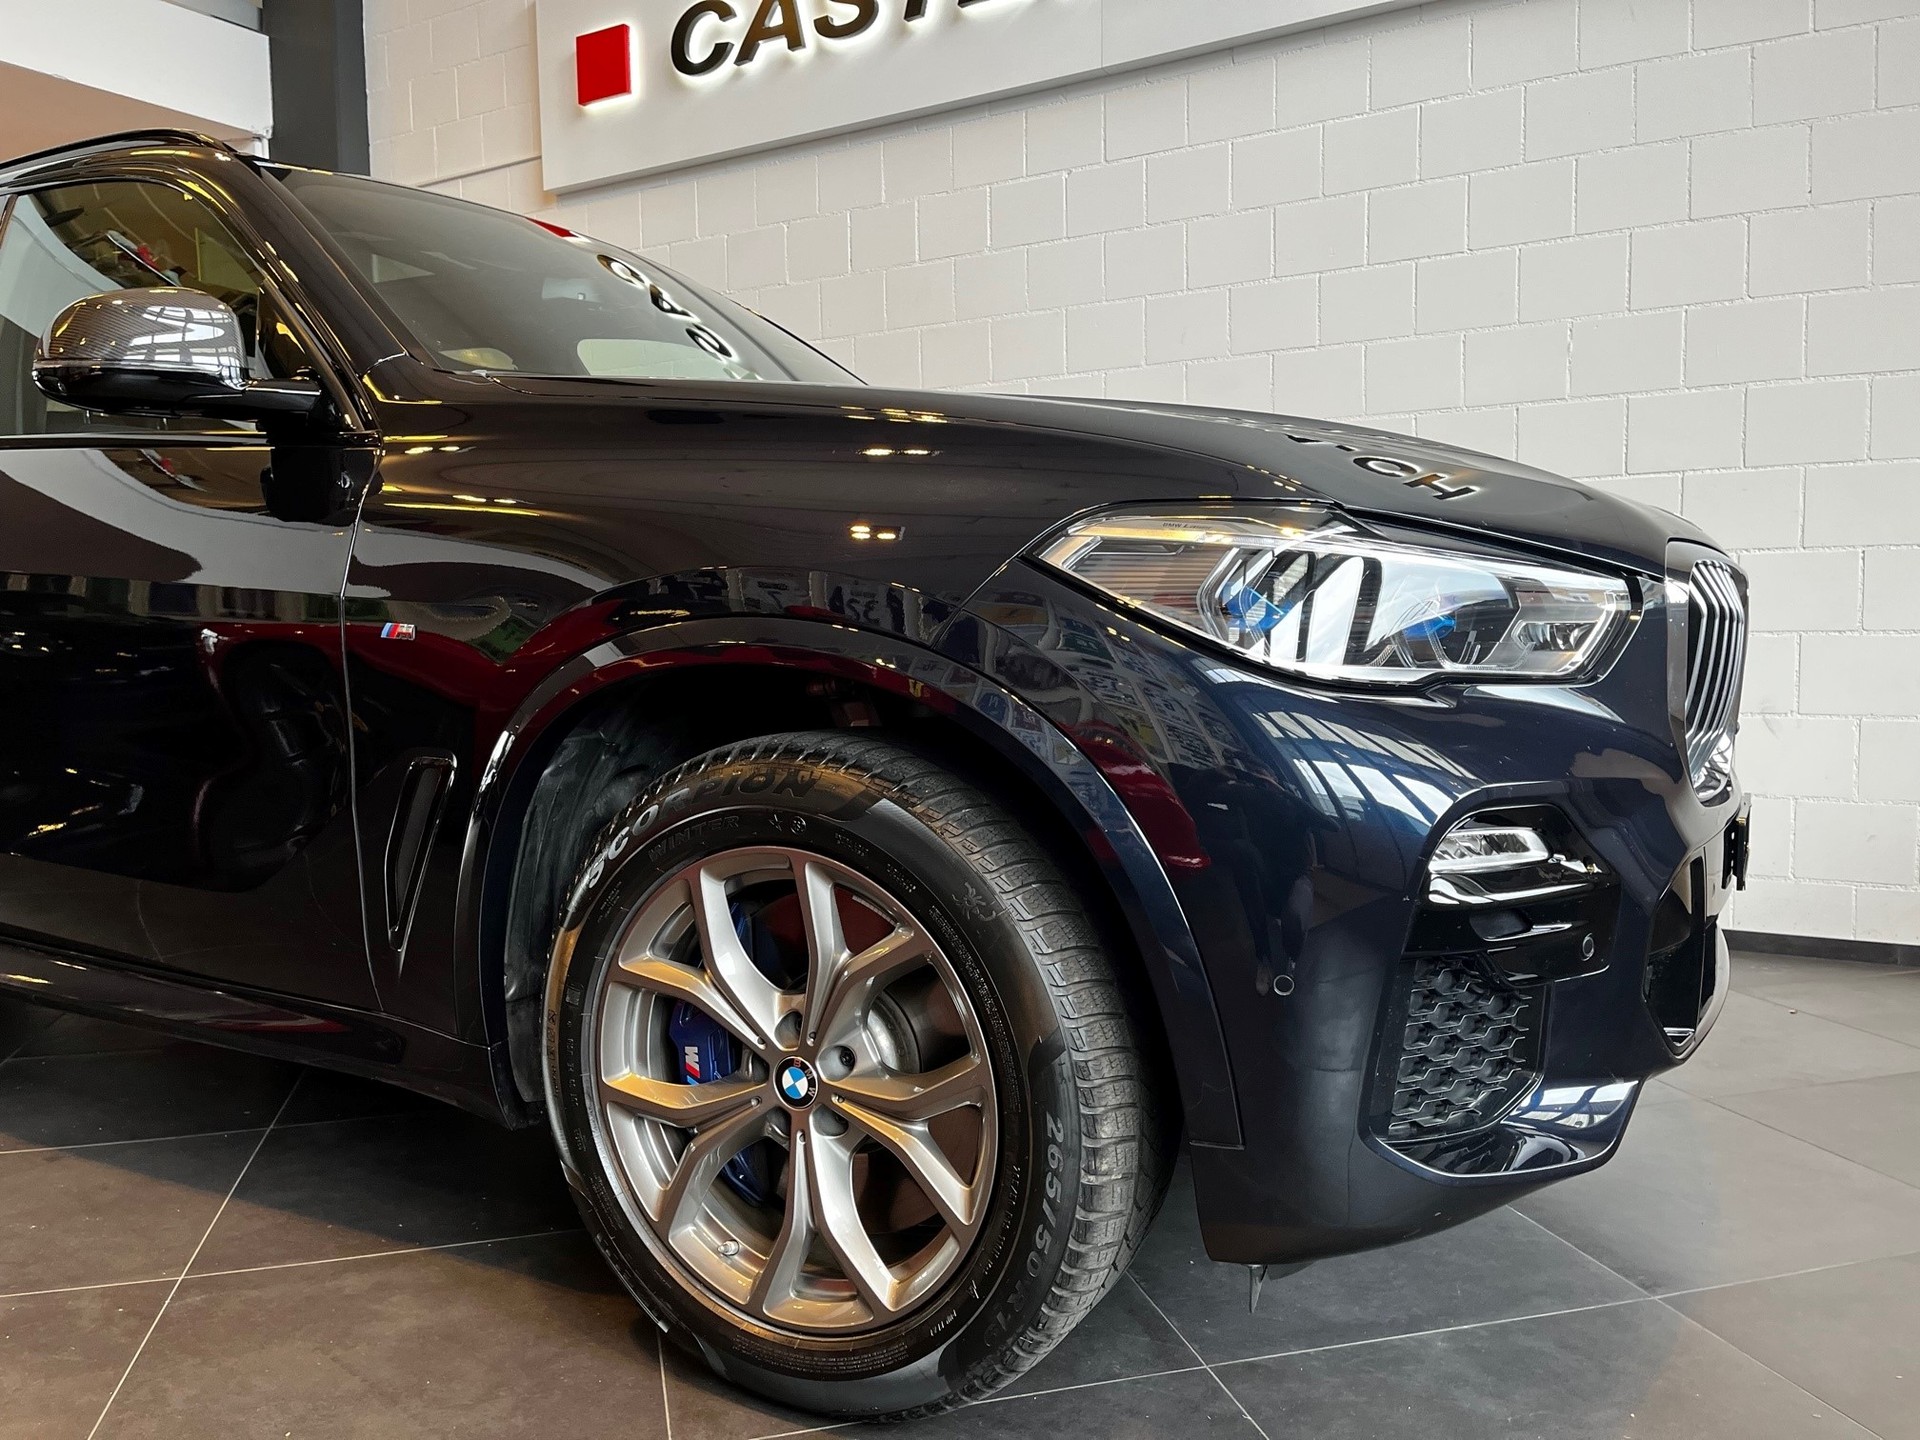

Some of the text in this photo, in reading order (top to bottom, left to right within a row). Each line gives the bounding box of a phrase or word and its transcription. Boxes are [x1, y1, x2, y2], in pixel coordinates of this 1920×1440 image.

[670, 0, 990, 76] CAS
[588, 769, 826, 889] SCORPION
[649, 815, 740, 862] WINTER
[1026, 1111, 1064, 1278] 265/50
